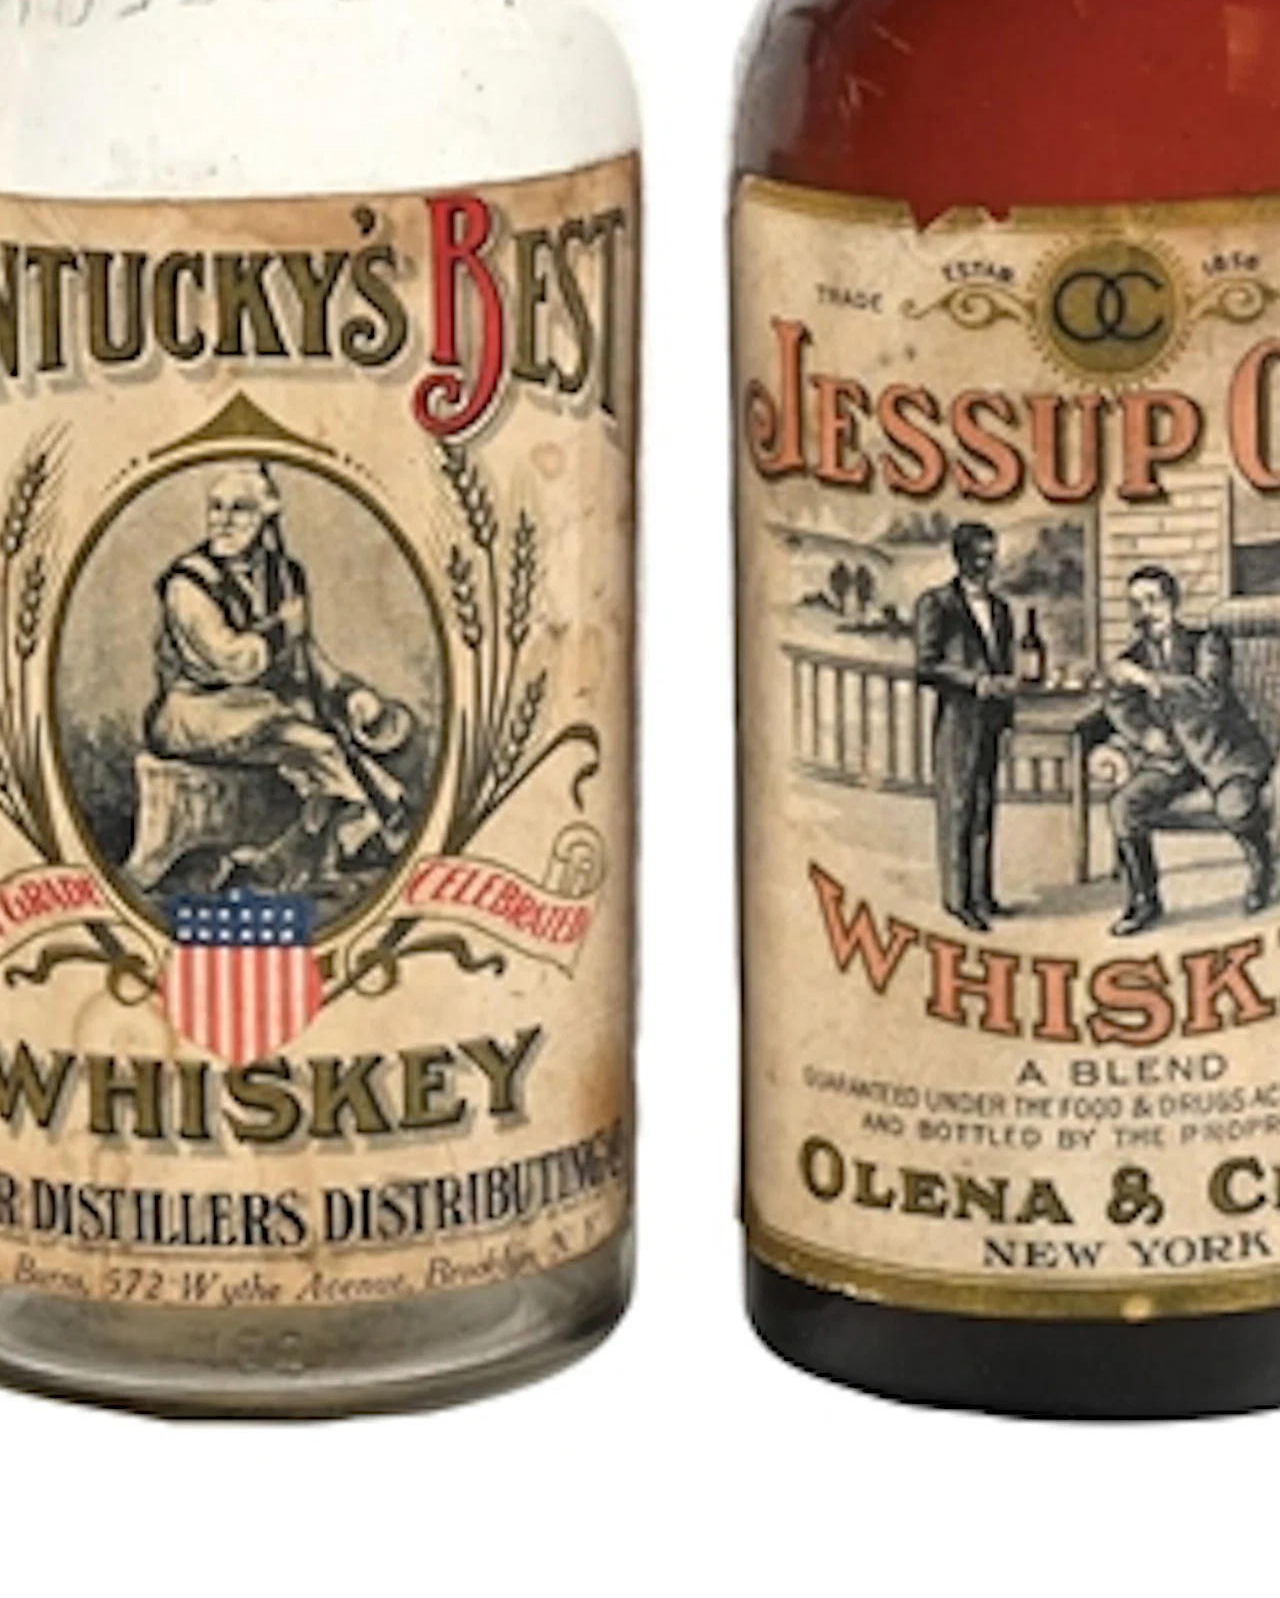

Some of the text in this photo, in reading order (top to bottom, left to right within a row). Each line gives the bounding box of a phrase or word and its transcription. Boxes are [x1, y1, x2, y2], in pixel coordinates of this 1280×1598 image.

[413, 192, 625, 438] BEST
[747, 316, 1202, 502] JESSUP
[405, 860, 592, 945] CELEBRATED
[1016, 1052, 1230, 1088] A BLEND
[861, 1108, 905, 1138] AND
[917, 1119, 1043, 1150] BOTTLED
[1058, 1127, 1096, 1151] BY
[1111, 1123, 1165, 1149] THE
[925, 1088, 1007, 1117] UNDER
[1014, 1097, 1055, 1119] THE
[1058, 1095, 1123, 1121] FOOD
[1130, 1095, 1154, 1120] &
[1157, 1086, 1246, 1119] DRUGS
[799, 1134, 1073, 1226] OLENA
[1106, 1165, 1165, 1226] &
[30, 1177, 308, 1248] DISTILLERS
[982, 1230, 1273, 1270] NEW YORK
[103, 1268, 165, 1301] 572
